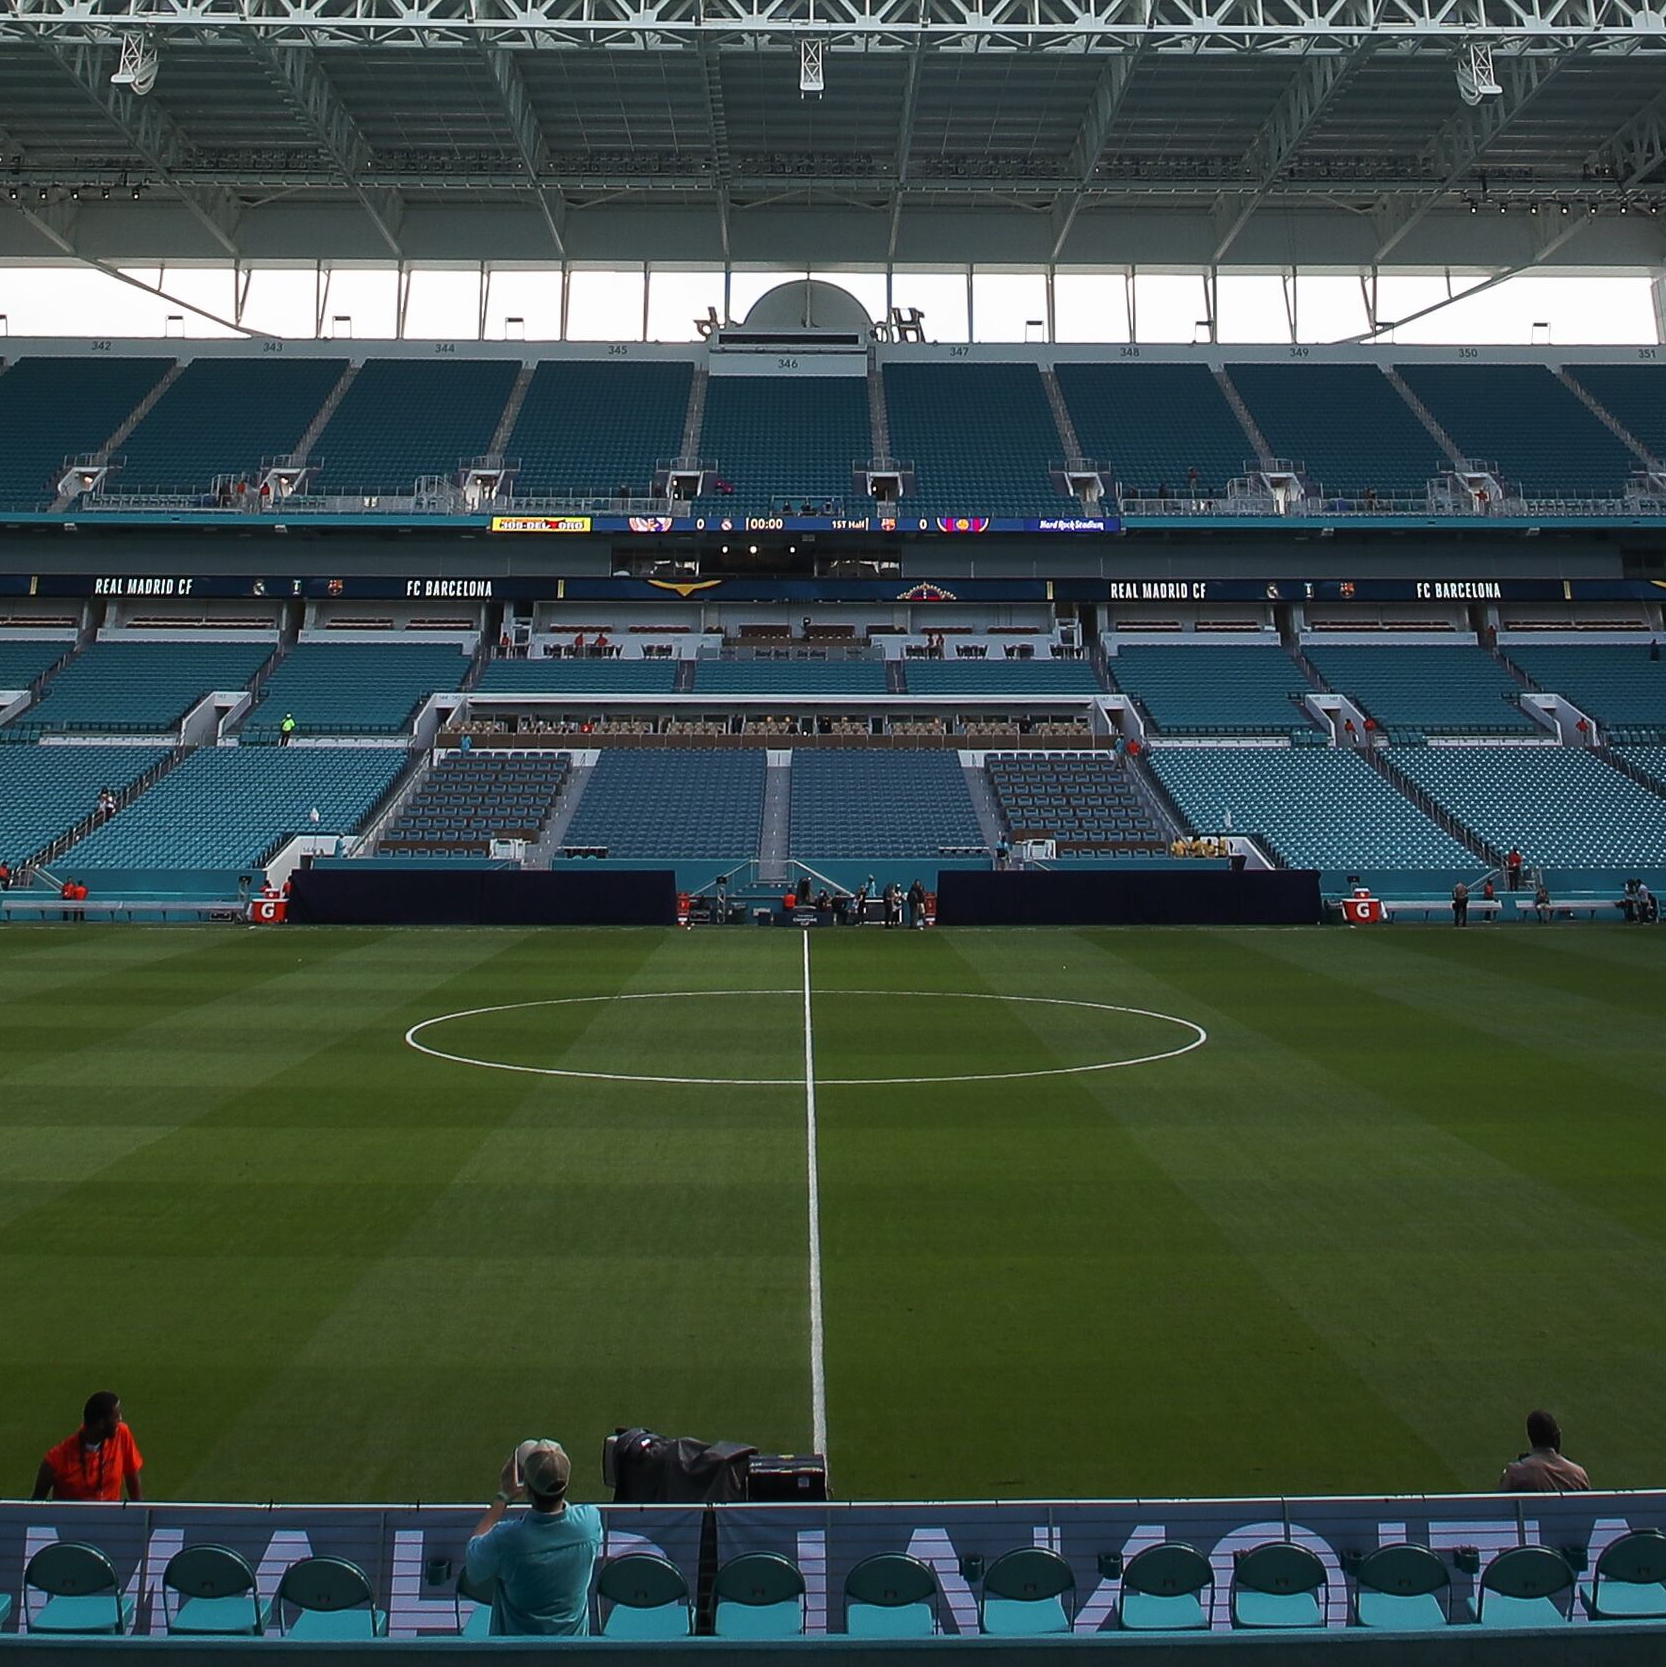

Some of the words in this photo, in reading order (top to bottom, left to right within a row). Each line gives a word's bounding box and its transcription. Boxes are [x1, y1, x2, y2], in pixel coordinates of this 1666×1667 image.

[91, 341, 111, 351] 342
[263, 342, 283, 352] 343
[435, 343, 455, 353] 344
[608, 345, 628, 355] 345
[950, 346, 970, 357] 347
[1120, 347, 1140, 357] 348
[1289, 348, 1309, 358] 349
[1459, 348, 1478, 358] 350
[1638, 348, 1656, 358] 351
[778, 358, 798, 369] 346
[696, 518, 705, 529] 0
[750, 518, 783, 529] 00:00
[832, 520, 846, 529] 1ST
[919, 519, 928, 530] 0
[95, 578, 122, 594] REAL
[127, 578, 174, 594] MADRID
[178, 579, 193, 594] CF
[406, 581, 420, 596] FC
[425, 581, 492, 597] BARCELONA
[1111, 583, 1139, 599] REAL
[1142, 583, 1188, 599] MADRID
[1192, 583, 1206, 599] CF
[1416, 583, 1431, 598] FC
[1435, 583, 1501, 598] BARCELONA
[261, 902, 275, 918] G
[1356, 902, 1370, 919] G
